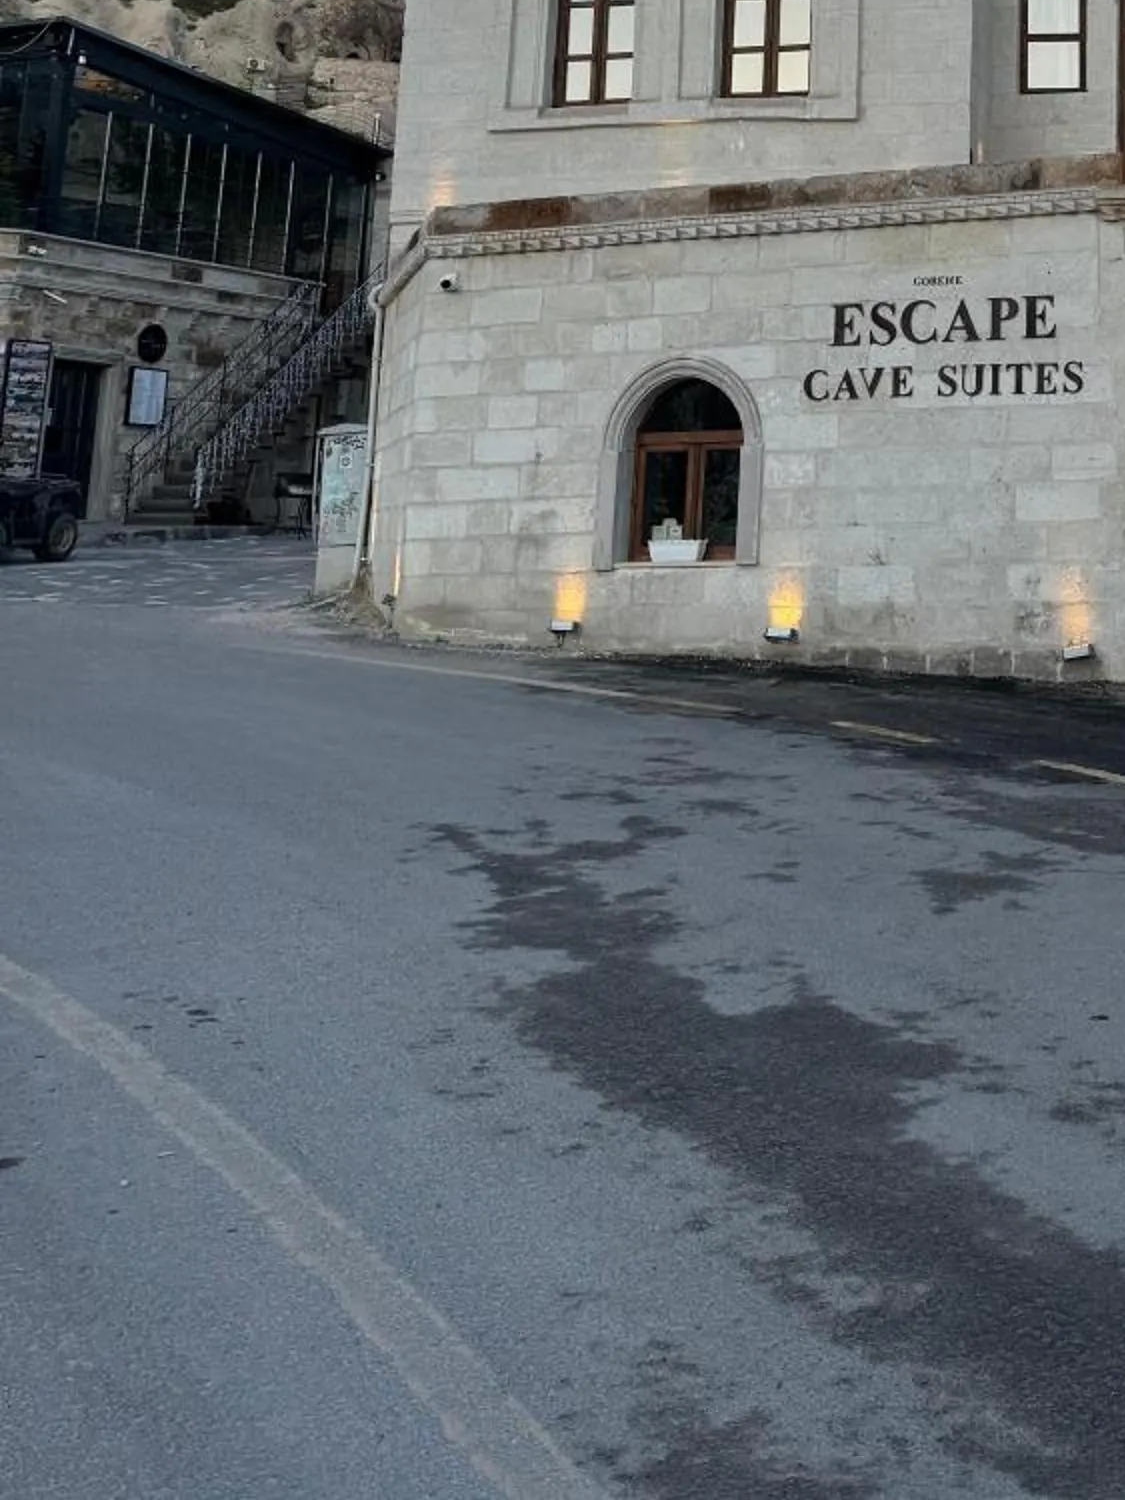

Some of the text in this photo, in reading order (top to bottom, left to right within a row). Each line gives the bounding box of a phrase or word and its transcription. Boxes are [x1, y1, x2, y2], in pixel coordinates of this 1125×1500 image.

[828, 294, 1057, 347] ESCAPE
[803, 360, 1085, 402] CAVE SUITES
